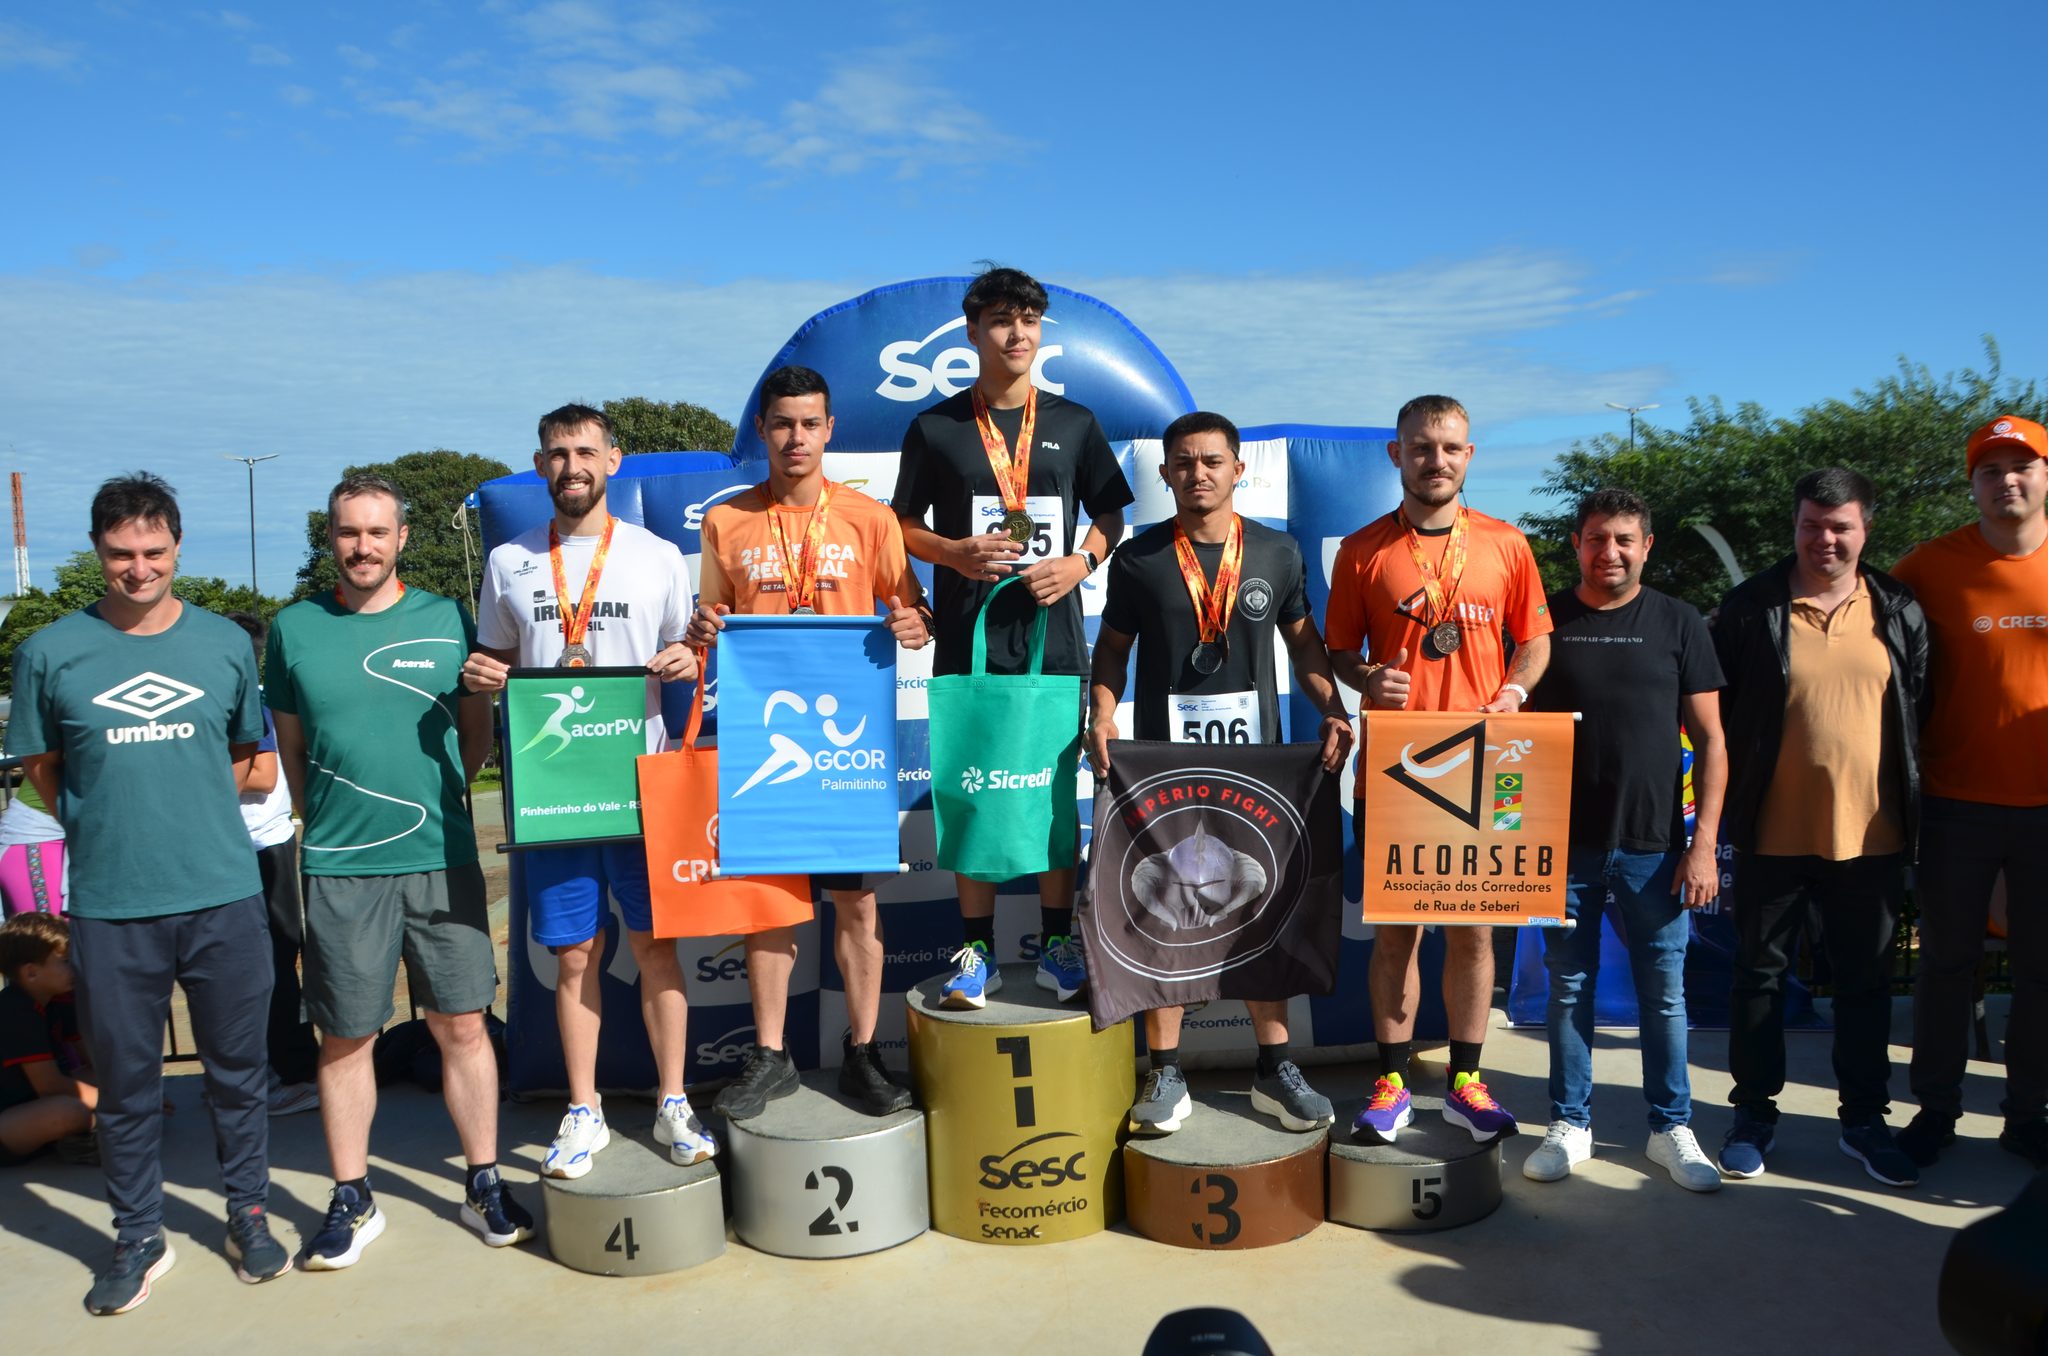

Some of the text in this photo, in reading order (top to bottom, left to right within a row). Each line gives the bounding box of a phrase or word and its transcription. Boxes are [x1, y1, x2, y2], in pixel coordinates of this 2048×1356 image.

[876, 340, 1065, 402] Sec
[1042, 441, 1060, 450] FILA
[1253, 476, 1271, 488] RS
[1177, 703, 1199, 712] Sesc
[107, 720, 195, 744] umbro
[571, 719, 643, 738] acorPV
[1183, 717, 1250, 744] 506
[814, 749, 886, 771] GCOR
[821, 778, 887, 790] Palmitinho
[987, 767, 1052, 789] Sicredi
[520, 804, 581, 817] Pinheirinho
[583, 803, 597, 812] do
[598, 801, 620, 811] Vale
[1221, 788, 1280, 828] FIGHT
[1386, 844, 1553, 877] ACORSEB
[1383, 879, 1552, 894] Associação dos Corredores
[1414, 899, 1520, 912] de Rua de Seberi
[883, 950, 933, 964] mércio
[696, 956, 749, 982] Se
[1181, 1016, 1253, 1029] Fecomérc
[696, 1042, 756, 1065] Ses
[996, 1035, 1036, 1128] 1
[979, 1151, 1087, 1190] Sesc
[805, 1165, 859, 1236] 2
[979, 1196, 1088, 1219] Fecomércio
[1190, 1174, 1241, 1245] 3
[1412, 1177, 1442, 1221] 5
[604, 1217, 640, 1261] 4
[981, 1224, 1041, 1240] Senac
